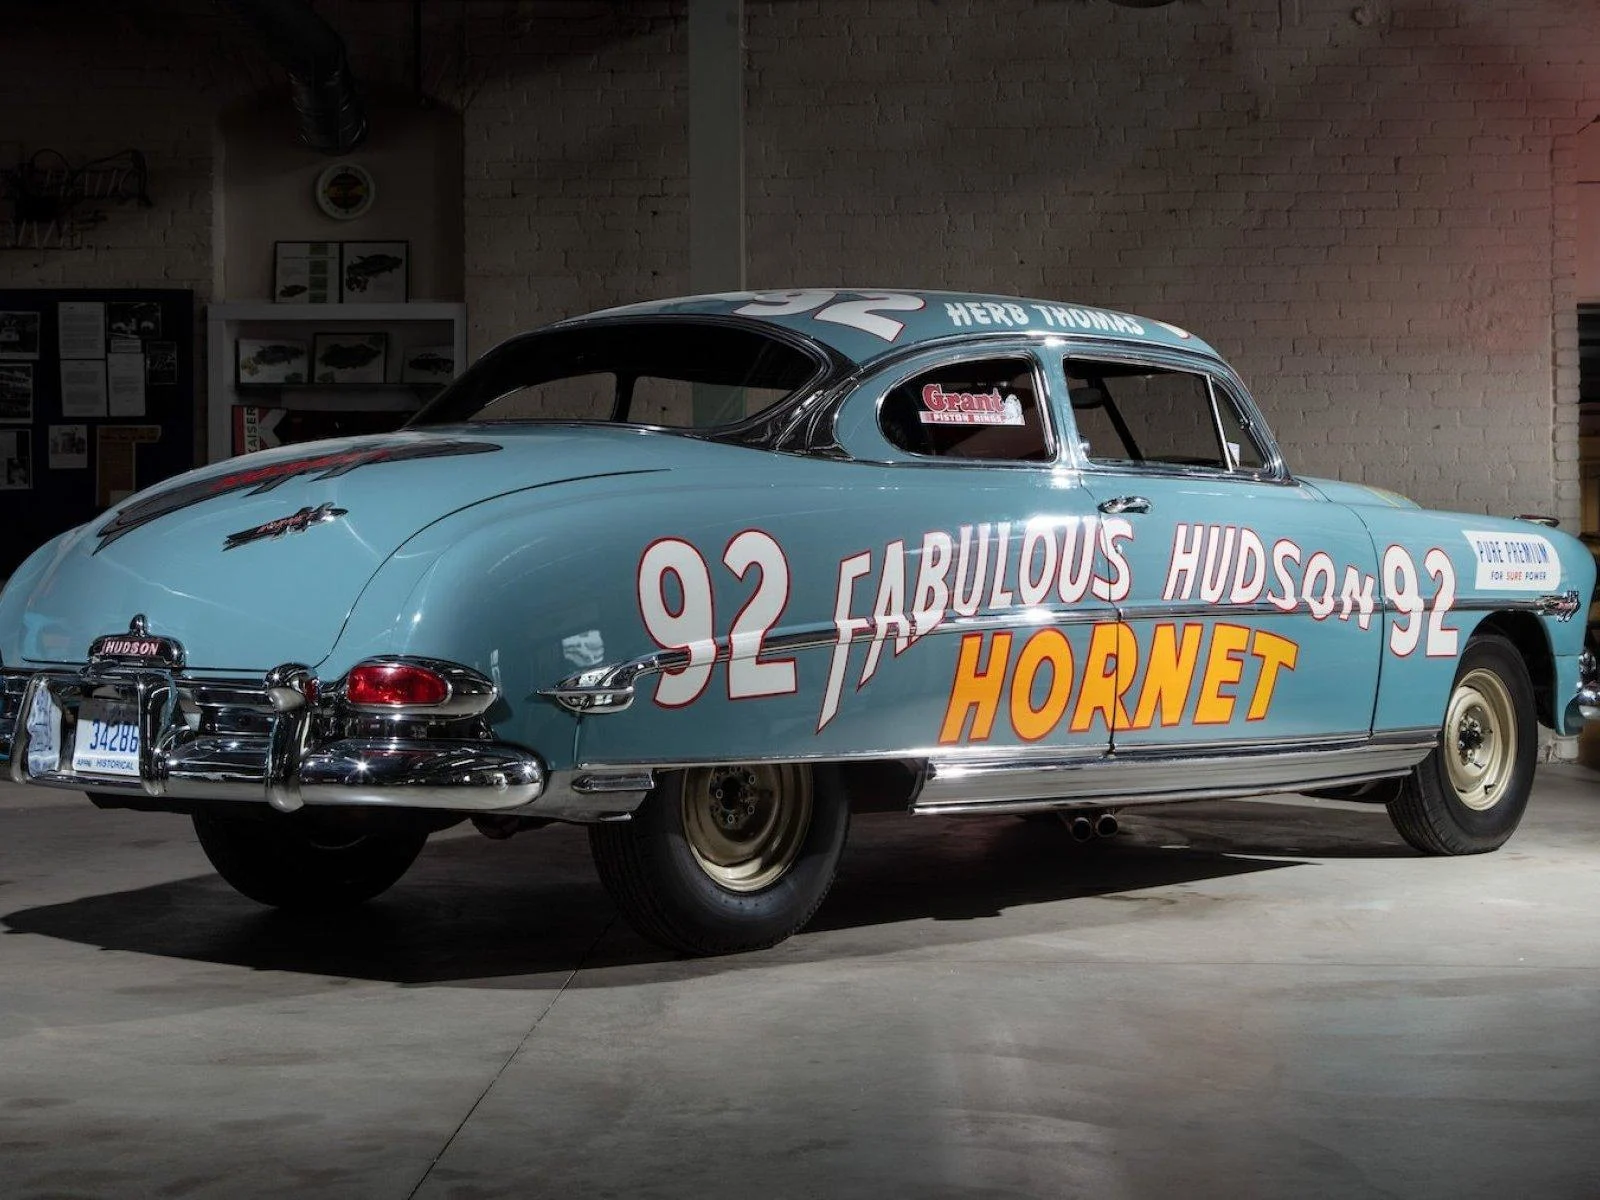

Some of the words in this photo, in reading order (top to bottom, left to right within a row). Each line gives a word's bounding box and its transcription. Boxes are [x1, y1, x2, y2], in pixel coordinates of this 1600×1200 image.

[731, 289, 926, 343] 92
[944, 302, 1030, 327] HERB
[1031, 304, 1145, 336] THOMAS
[922, 383, 1005, 412] Grant
[933, 413, 968, 422] PISTON
[974, 414, 1003, 423] RINGS
[1476, 540, 1503, 563] PURE
[1505, 541, 1550, 564] PREMIUM
[1490, 571, 1503, 581] FOR
[1506, 571, 1523, 581] SURE
[1525, 571, 1547, 581] POWER
[1382, 544, 1459, 658] 92
[637, 528, 798, 709] 92
[815, 515, 1135, 735] FABULOUS
[1162, 523, 1375, 631] HUDSON
[101, 639, 159, 655] HUDSON
[939, 621, 1299, 746] HORNET
[90, 719, 139, 753] 34286
[95, 758, 135, 771] HISTORICAL
